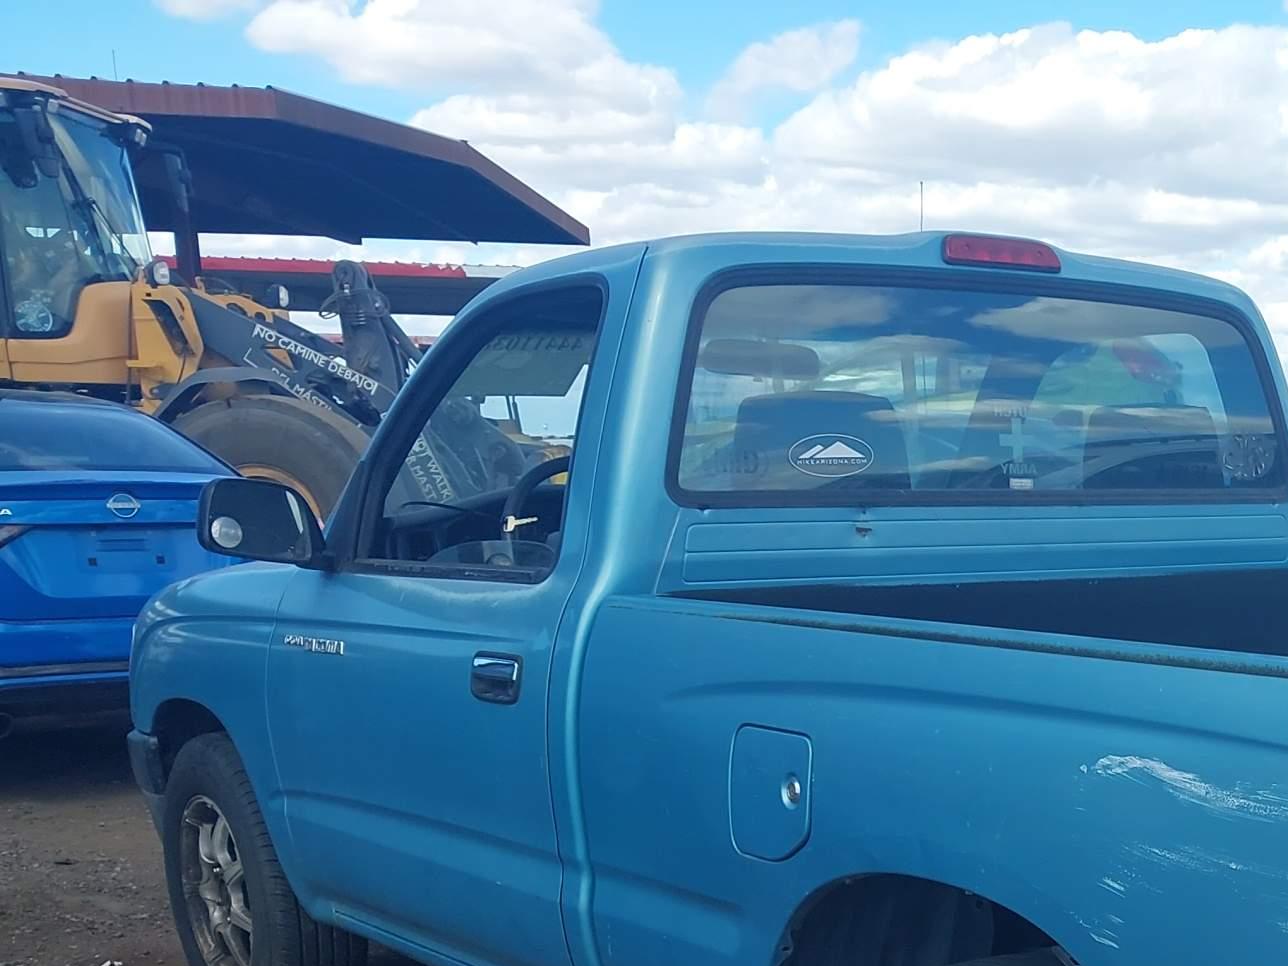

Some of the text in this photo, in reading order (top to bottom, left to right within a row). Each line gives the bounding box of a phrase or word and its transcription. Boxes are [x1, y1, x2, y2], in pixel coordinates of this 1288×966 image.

[254, 325, 375, 392] NO CAMINE DEBAJO
